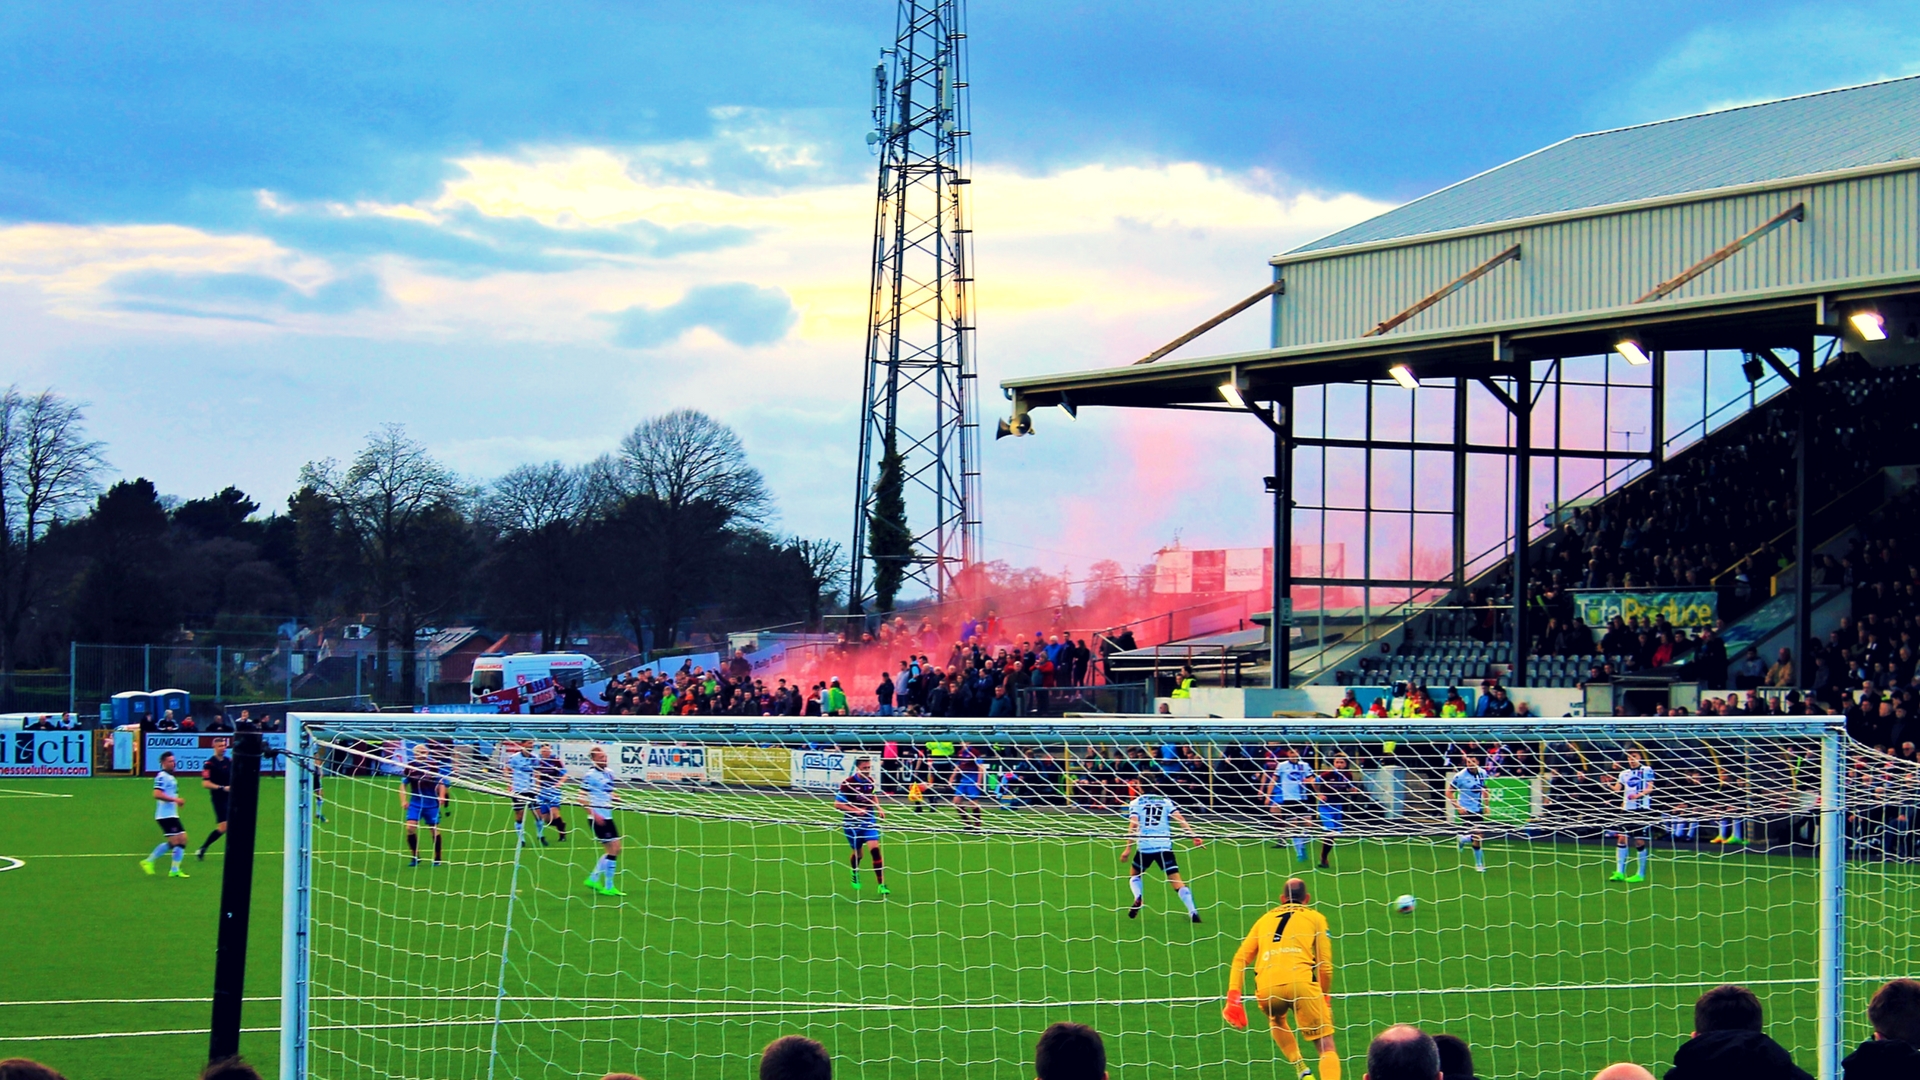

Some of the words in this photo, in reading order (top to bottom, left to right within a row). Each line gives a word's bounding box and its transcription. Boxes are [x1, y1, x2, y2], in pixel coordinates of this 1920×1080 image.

[148, 738, 193, 747] DUNDALK
[648, 748, 704, 768] ANORD
[1142, 804, 1163, 827] 19
[1272, 911, 1295, 942] 1
